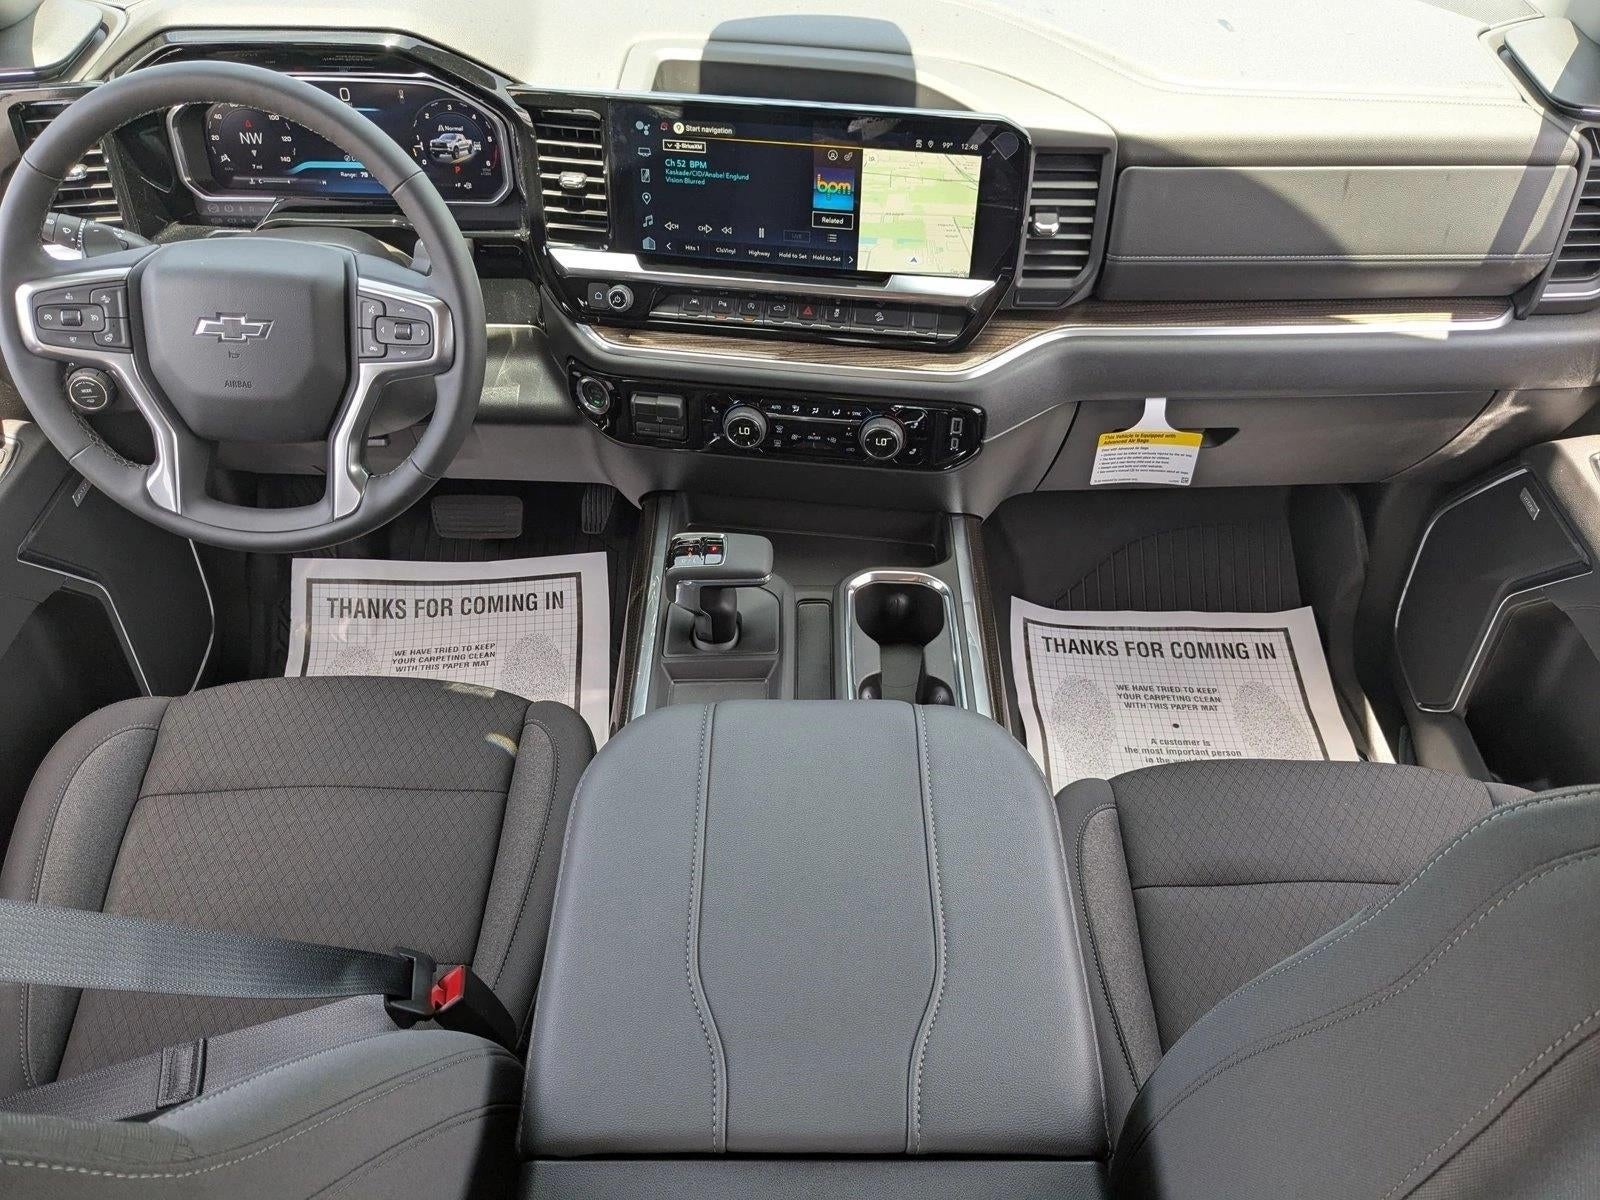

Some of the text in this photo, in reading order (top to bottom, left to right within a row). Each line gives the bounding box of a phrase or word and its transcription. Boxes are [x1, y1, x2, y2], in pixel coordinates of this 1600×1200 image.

[340, 87, 351, 102] 0
[685, 124, 733, 135] Start navigation
[239, 131, 263, 145] NW
[961, 143, 979, 151] 12:48
[664, 158, 707, 169] Ch 52 BPM
[665, 176, 706, 185] Vision Blurred
[725, 171, 750, 181] Englund
[817, 173, 852, 199] bpm
[821, 216, 844, 225] Related
[748, 249, 771, 258] Highway
[224, 380, 252, 389] AIRBAG
[327, 590, 564, 619] THANKS FOR COMING IN
[409, 647, 432, 656] HAVE
[433, 645, 460, 654] TRIED
[474, 642, 496, 651] KEEP
[1041, 636, 1277, 659] THANKS FOR COMING IN
[392, 651, 496, 665] YOUR CARPETING CLEAN
[395, 660, 490, 673] WITH THIS PAPER MAT
[1116, 684, 1130, 692] WE
[1196, 687, 1218, 695] KEEP
[1116, 692, 1221, 703] YOUR CARPETING CLEAN
[1200, 704, 1219, 712] MAT
[1124, 745, 1139, 754] the
[1165, 747, 1211, 757] important
